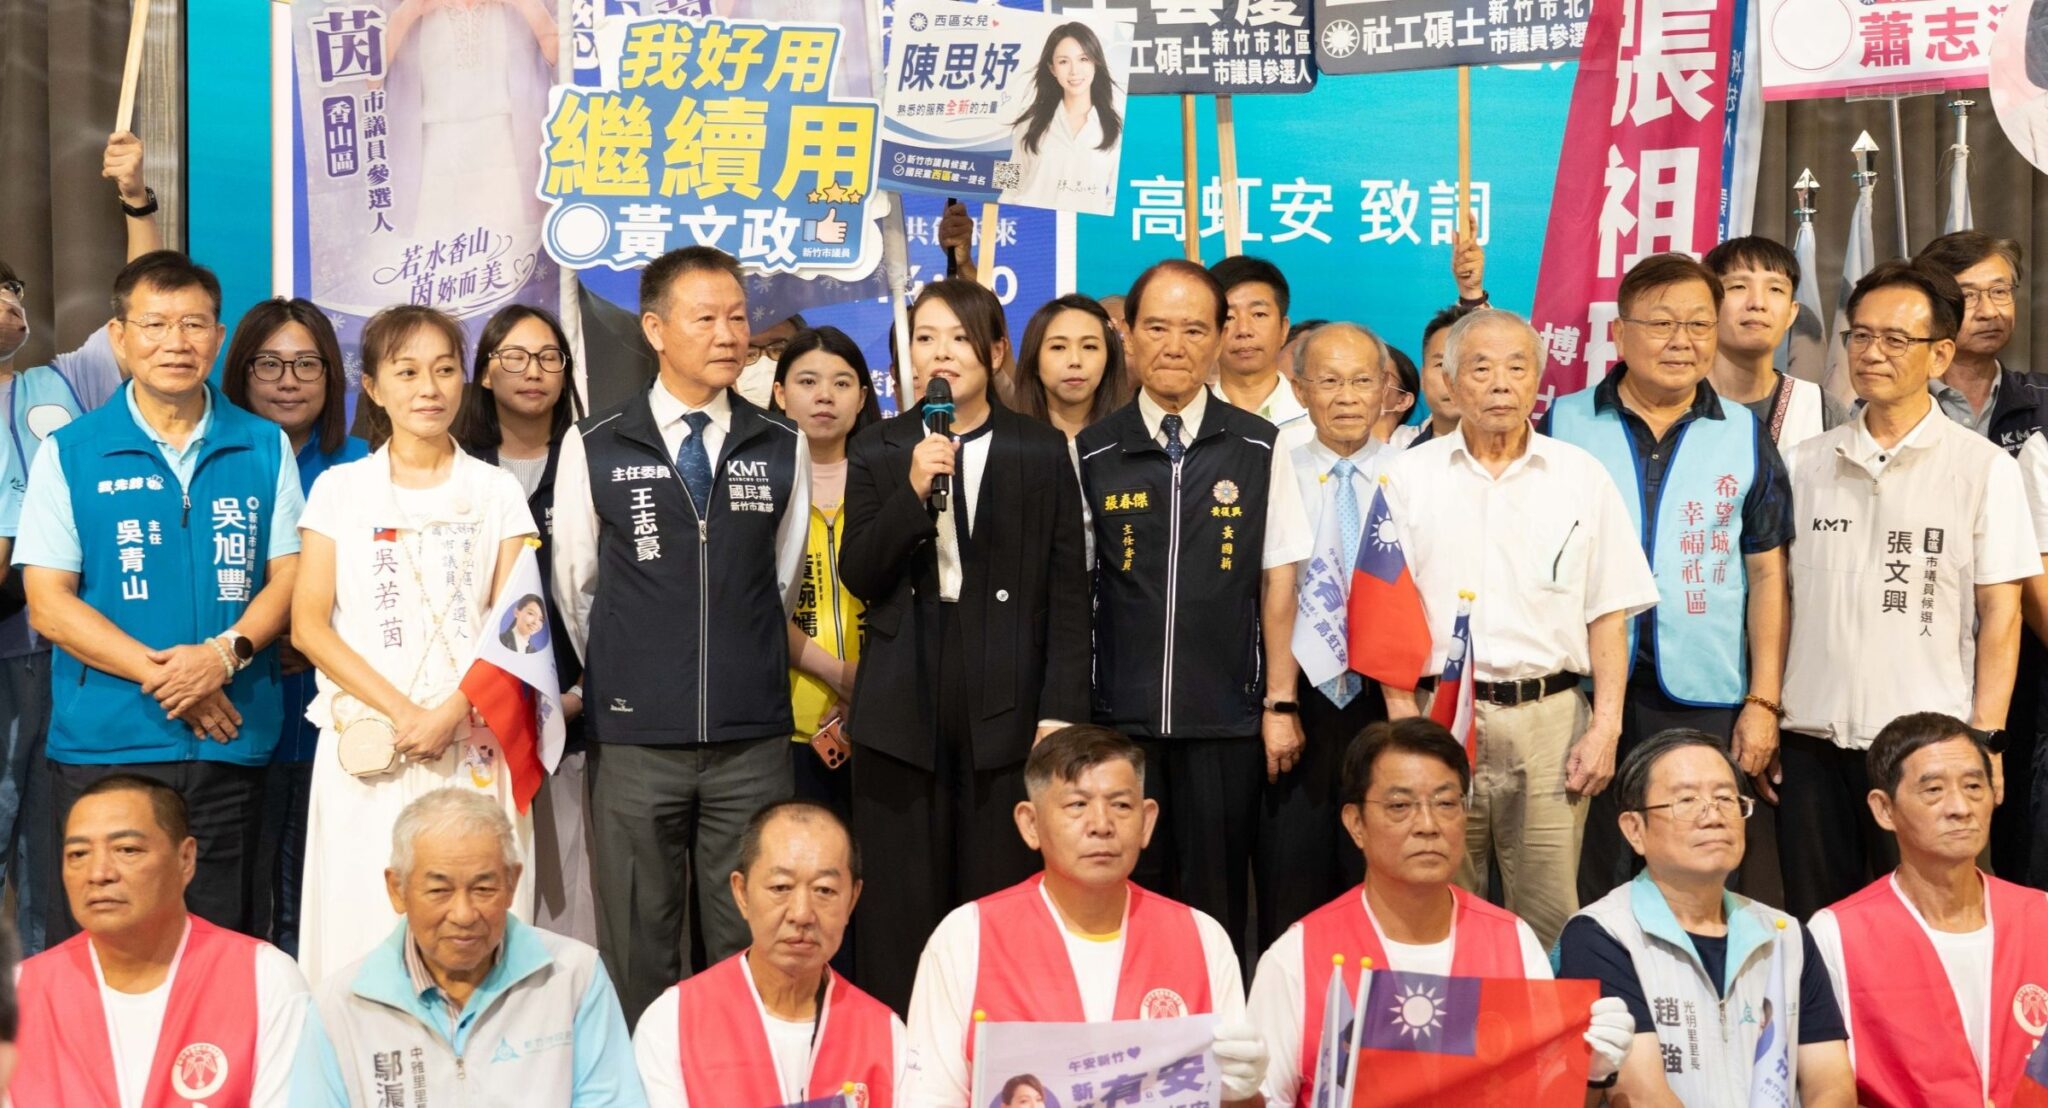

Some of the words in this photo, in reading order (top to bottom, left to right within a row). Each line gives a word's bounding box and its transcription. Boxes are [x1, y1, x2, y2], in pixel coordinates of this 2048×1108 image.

[934, 14, 988, 27] 西區女兒
[1362, 8, 1486, 55] 社工碩士
[1489, 0, 1593, 24] 新竹市北
[1489, 21, 1588, 54] 市議員參選
[1859, 5, 2008, 67] 蕭志
[312, 10, 384, 82] 茵
[622, 23, 837, 93] 我好用
[898, 42, 1021, 92] 陳思妤
[1212, 28, 1311, 56] 新竹市北區
[1214, 58, 1313, 85] 市議員參選人
[326, 101, 355, 174] 香山區
[363, 91, 394, 234] 市議員參選人
[545, 94, 876, 201] 繼續用
[906, 154, 976, 172] 新竹市議員候選人
[905, 166, 987, 186] 國民黨西區唯一提名
[1582, 0, 1717, 390] 張祖
[614, 204, 801, 264] 黃文政
[1130, 175, 1333, 244] 高虹安
[1360, 179, 1491, 246] 致詞
[398, 227, 489, 280] 若水香山
[802, 246, 850, 258] 新竹市議員
[410, 261, 507, 306] 茵妳而美
[611, 465, 672, 482] 主任委員
[727, 460, 768, 477] KMT
[728, 484, 773, 500] 國民黨
[148, 520, 162, 545] 主任
[630, 487, 662, 562] 王志豪
[730, 501, 774, 513] 新竹市黨部
[1709, 474, 1739, 585] 希望城市
[1812, 517, 1853, 533] KMT
[116, 519, 148, 600] 吳青山
[212, 497, 247, 601] 吳旭豐
[1680, 500, 1707, 615] 幸福社區
[1882, 530, 1914, 614] 張文興
[373, 548, 403, 648] 吳若茵
[1919, 556, 1938, 637] 市議員候選人
[1068, 1052, 1124, 1072] 午安新竹
[1654, 997, 1682, 1073] 趙強
[1684, 1001, 1700, 1070] 光明里里長
